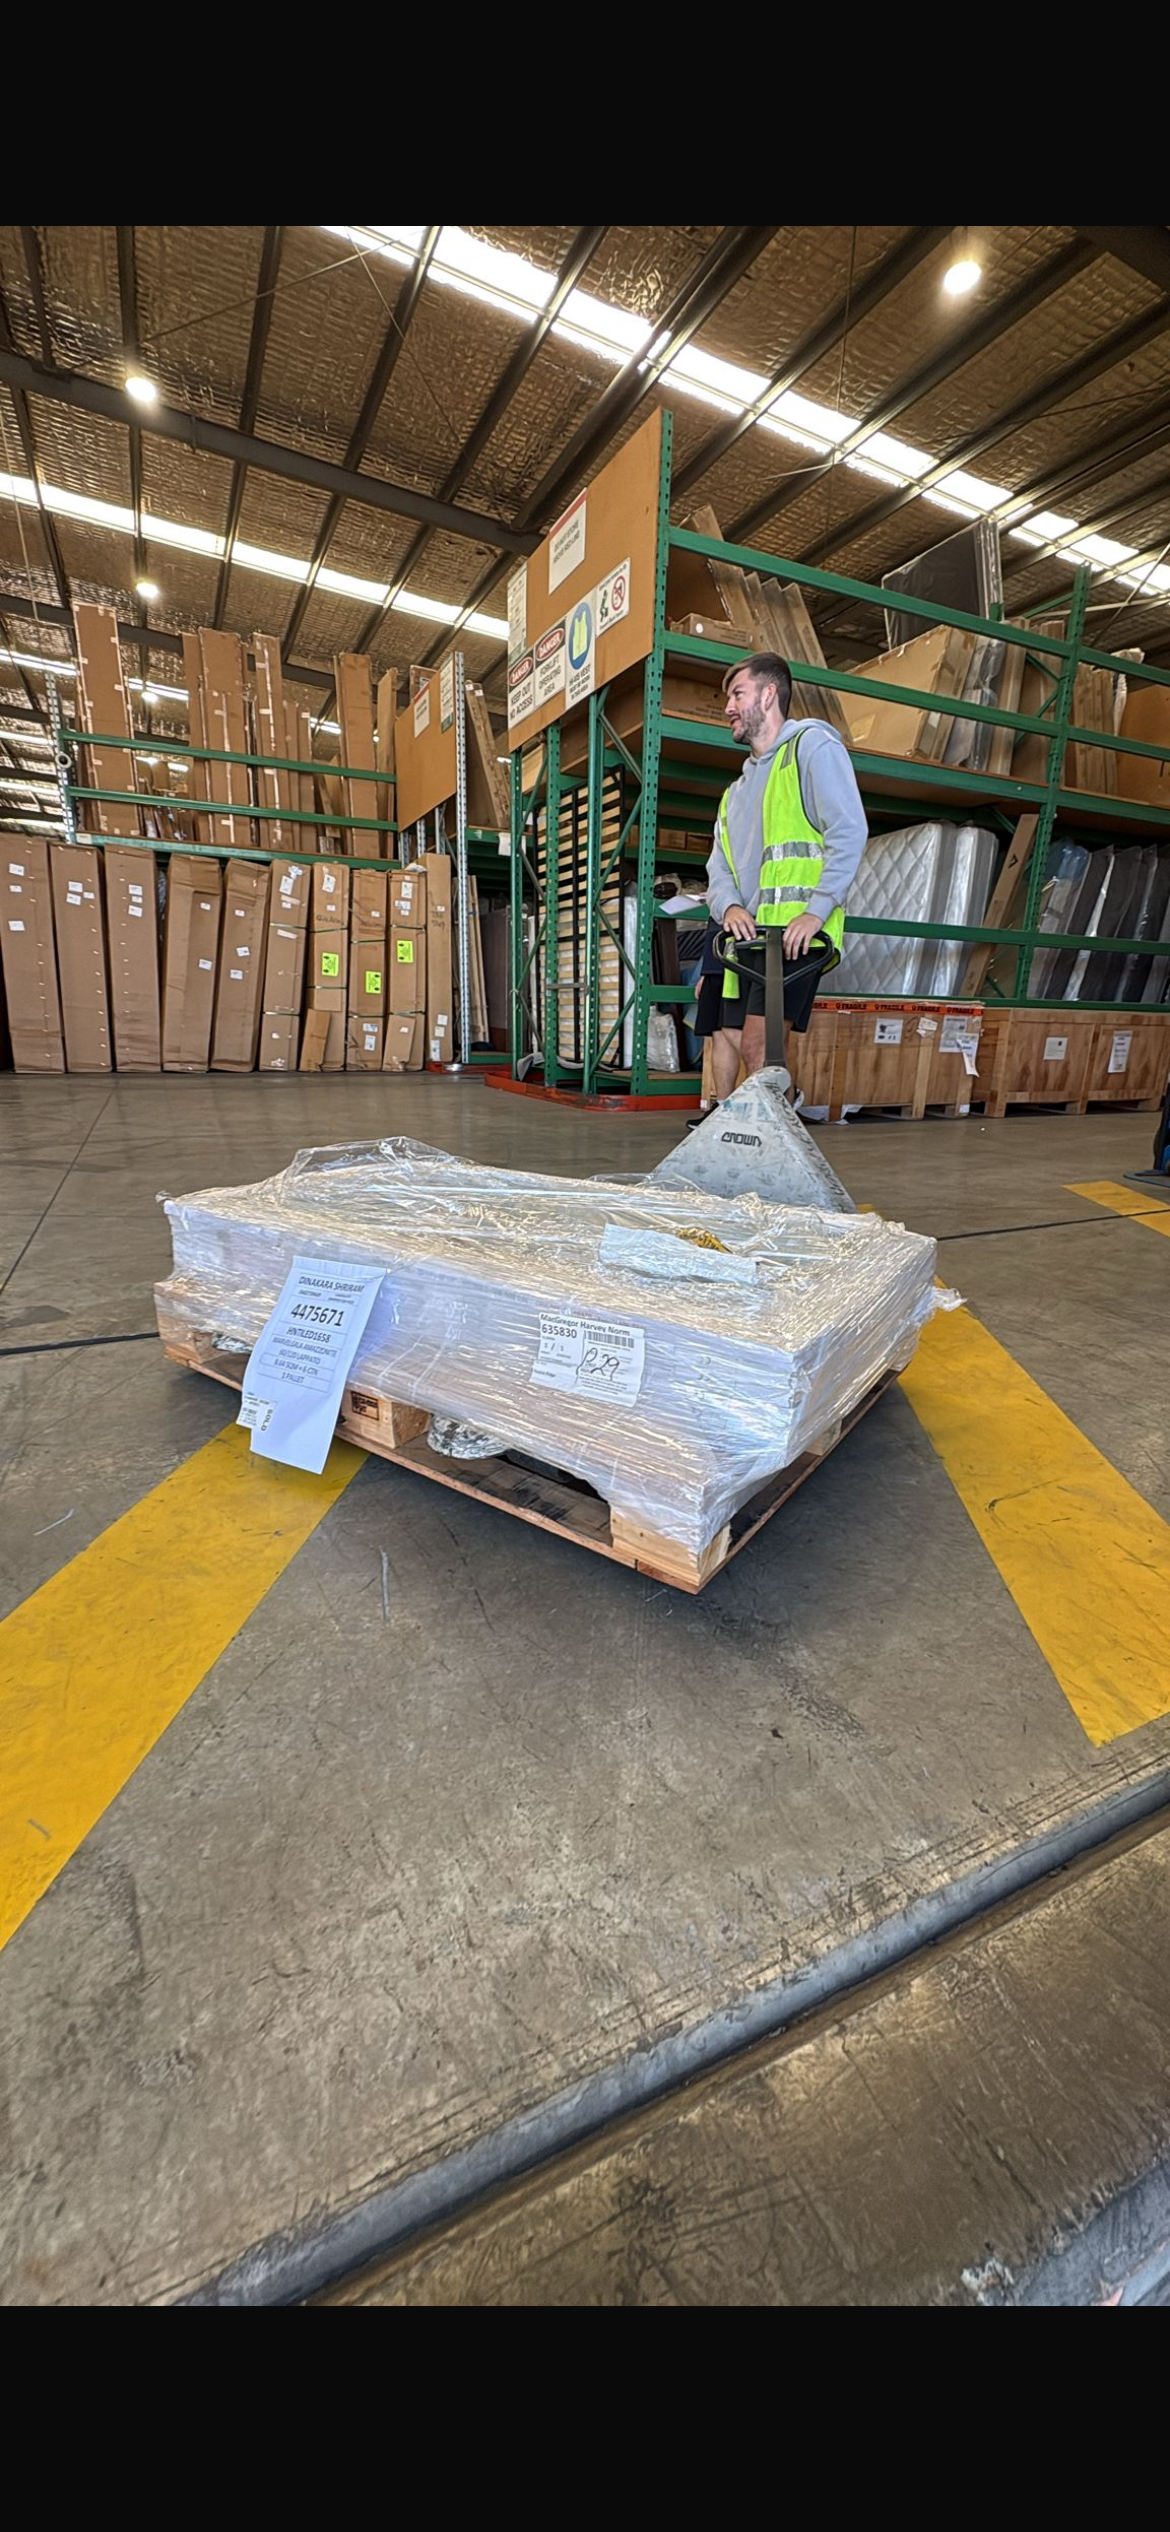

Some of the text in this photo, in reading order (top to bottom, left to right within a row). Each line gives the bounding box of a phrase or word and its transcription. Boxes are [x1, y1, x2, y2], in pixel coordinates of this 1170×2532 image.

[538, 631, 561, 660] DANGER
[510, 660, 530, 684] DANGER
[511, 681, 531, 706] KEEP OUT
[721, 1131, 762, 1147] CROWN
[290, 1303, 345, 1327] 4475671
[541, 1313, 579, 1327] MacGregor
[580, 1321, 606, 1333] Harvey
[608, 1326, 630, 1337] Norm
[541, 1324, 577, 1339] 635830
[261, 1408, 273, 1431] SOLD
